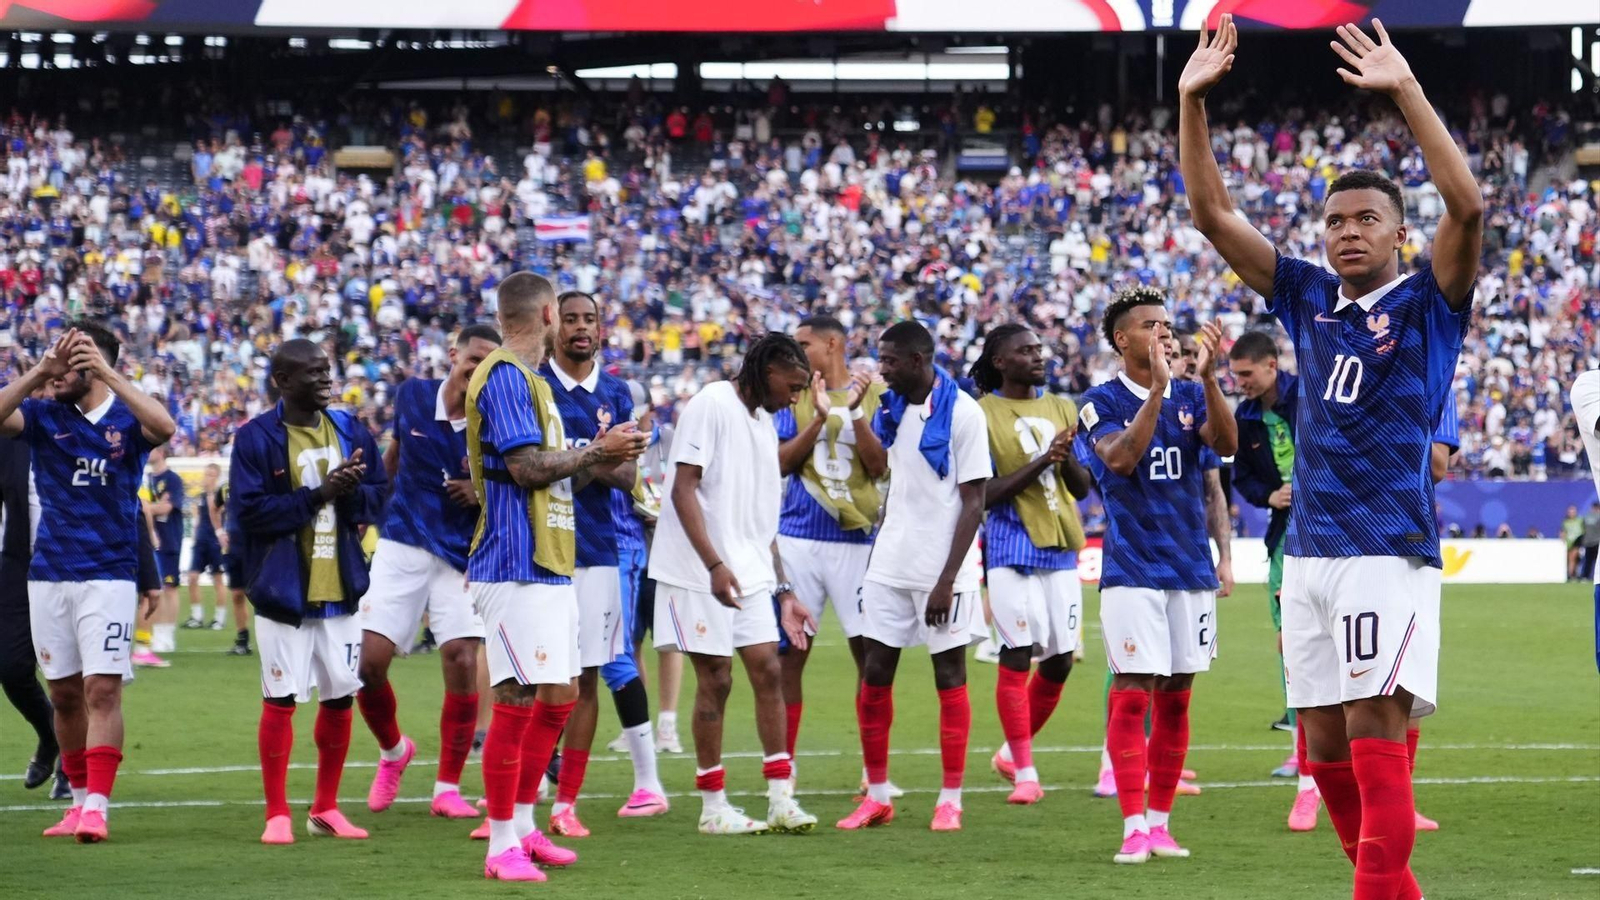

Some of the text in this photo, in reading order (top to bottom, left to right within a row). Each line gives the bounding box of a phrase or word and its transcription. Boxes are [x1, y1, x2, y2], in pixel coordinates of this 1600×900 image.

[1323, 354, 1363, 404] 10
[72, 457, 108, 486] 24
[1150, 447, 1182, 480] 20
[1068, 604, 1077, 630] 6
[103, 622, 132, 652] 24
[1342, 611, 1379, 663] 10
